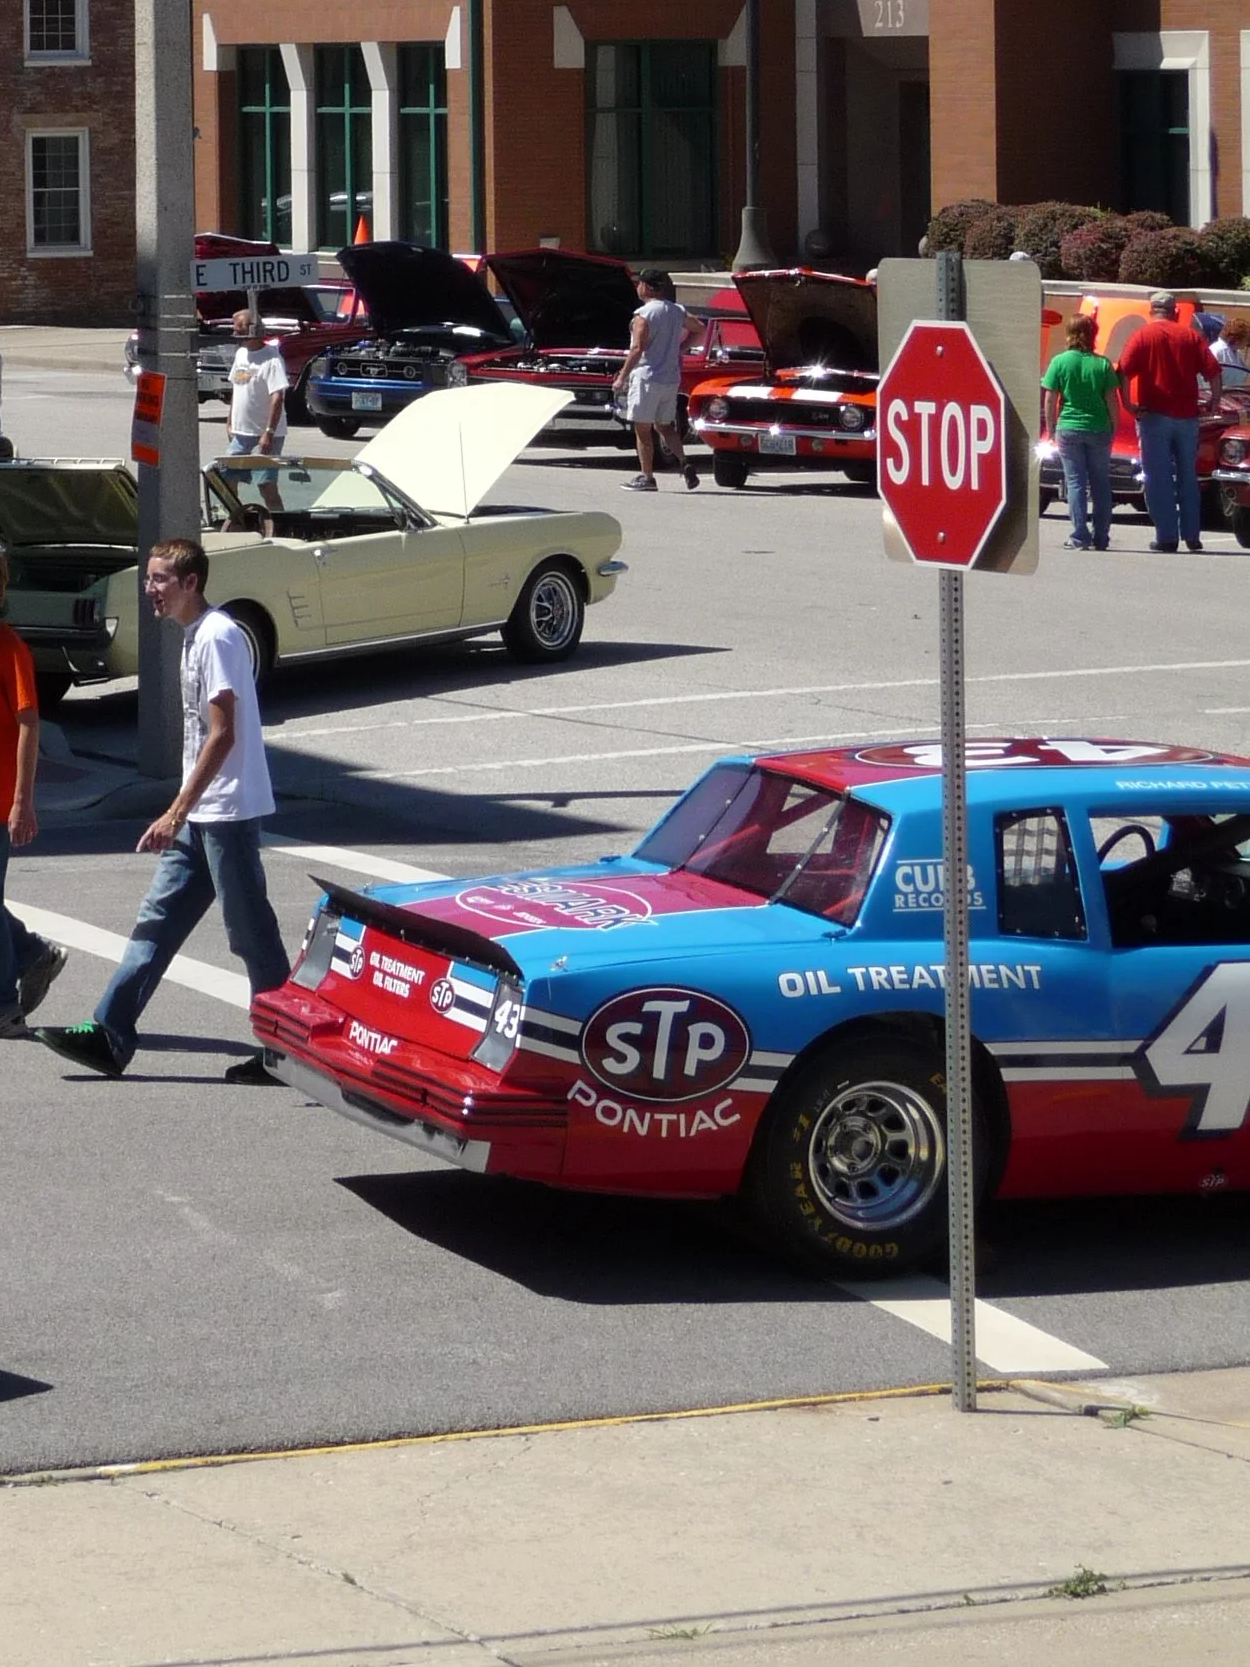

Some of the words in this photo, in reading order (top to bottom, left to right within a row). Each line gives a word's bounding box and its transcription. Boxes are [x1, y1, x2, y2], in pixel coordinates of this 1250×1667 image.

[874, 0, 905, 28] 213
[196, 264, 207, 286] E
[228, 260, 290, 285] THIRD
[300, 263, 312, 276] ST
[886, 399, 995, 491] STOP
[1115, 780, 1207, 790] RICHARD
[895, 865, 976, 893] CUB
[894, 892, 983, 909] RECODS
[431, 982, 453, 1009] STP
[778, 971, 841, 998] OIL
[494, 1000, 521, 1039] 43
[349, 1021, 398, 1054] PONTIAC
[602, 1000, 725, 1080] STP
[567, 1079, 741, 1138] PONTIAC
